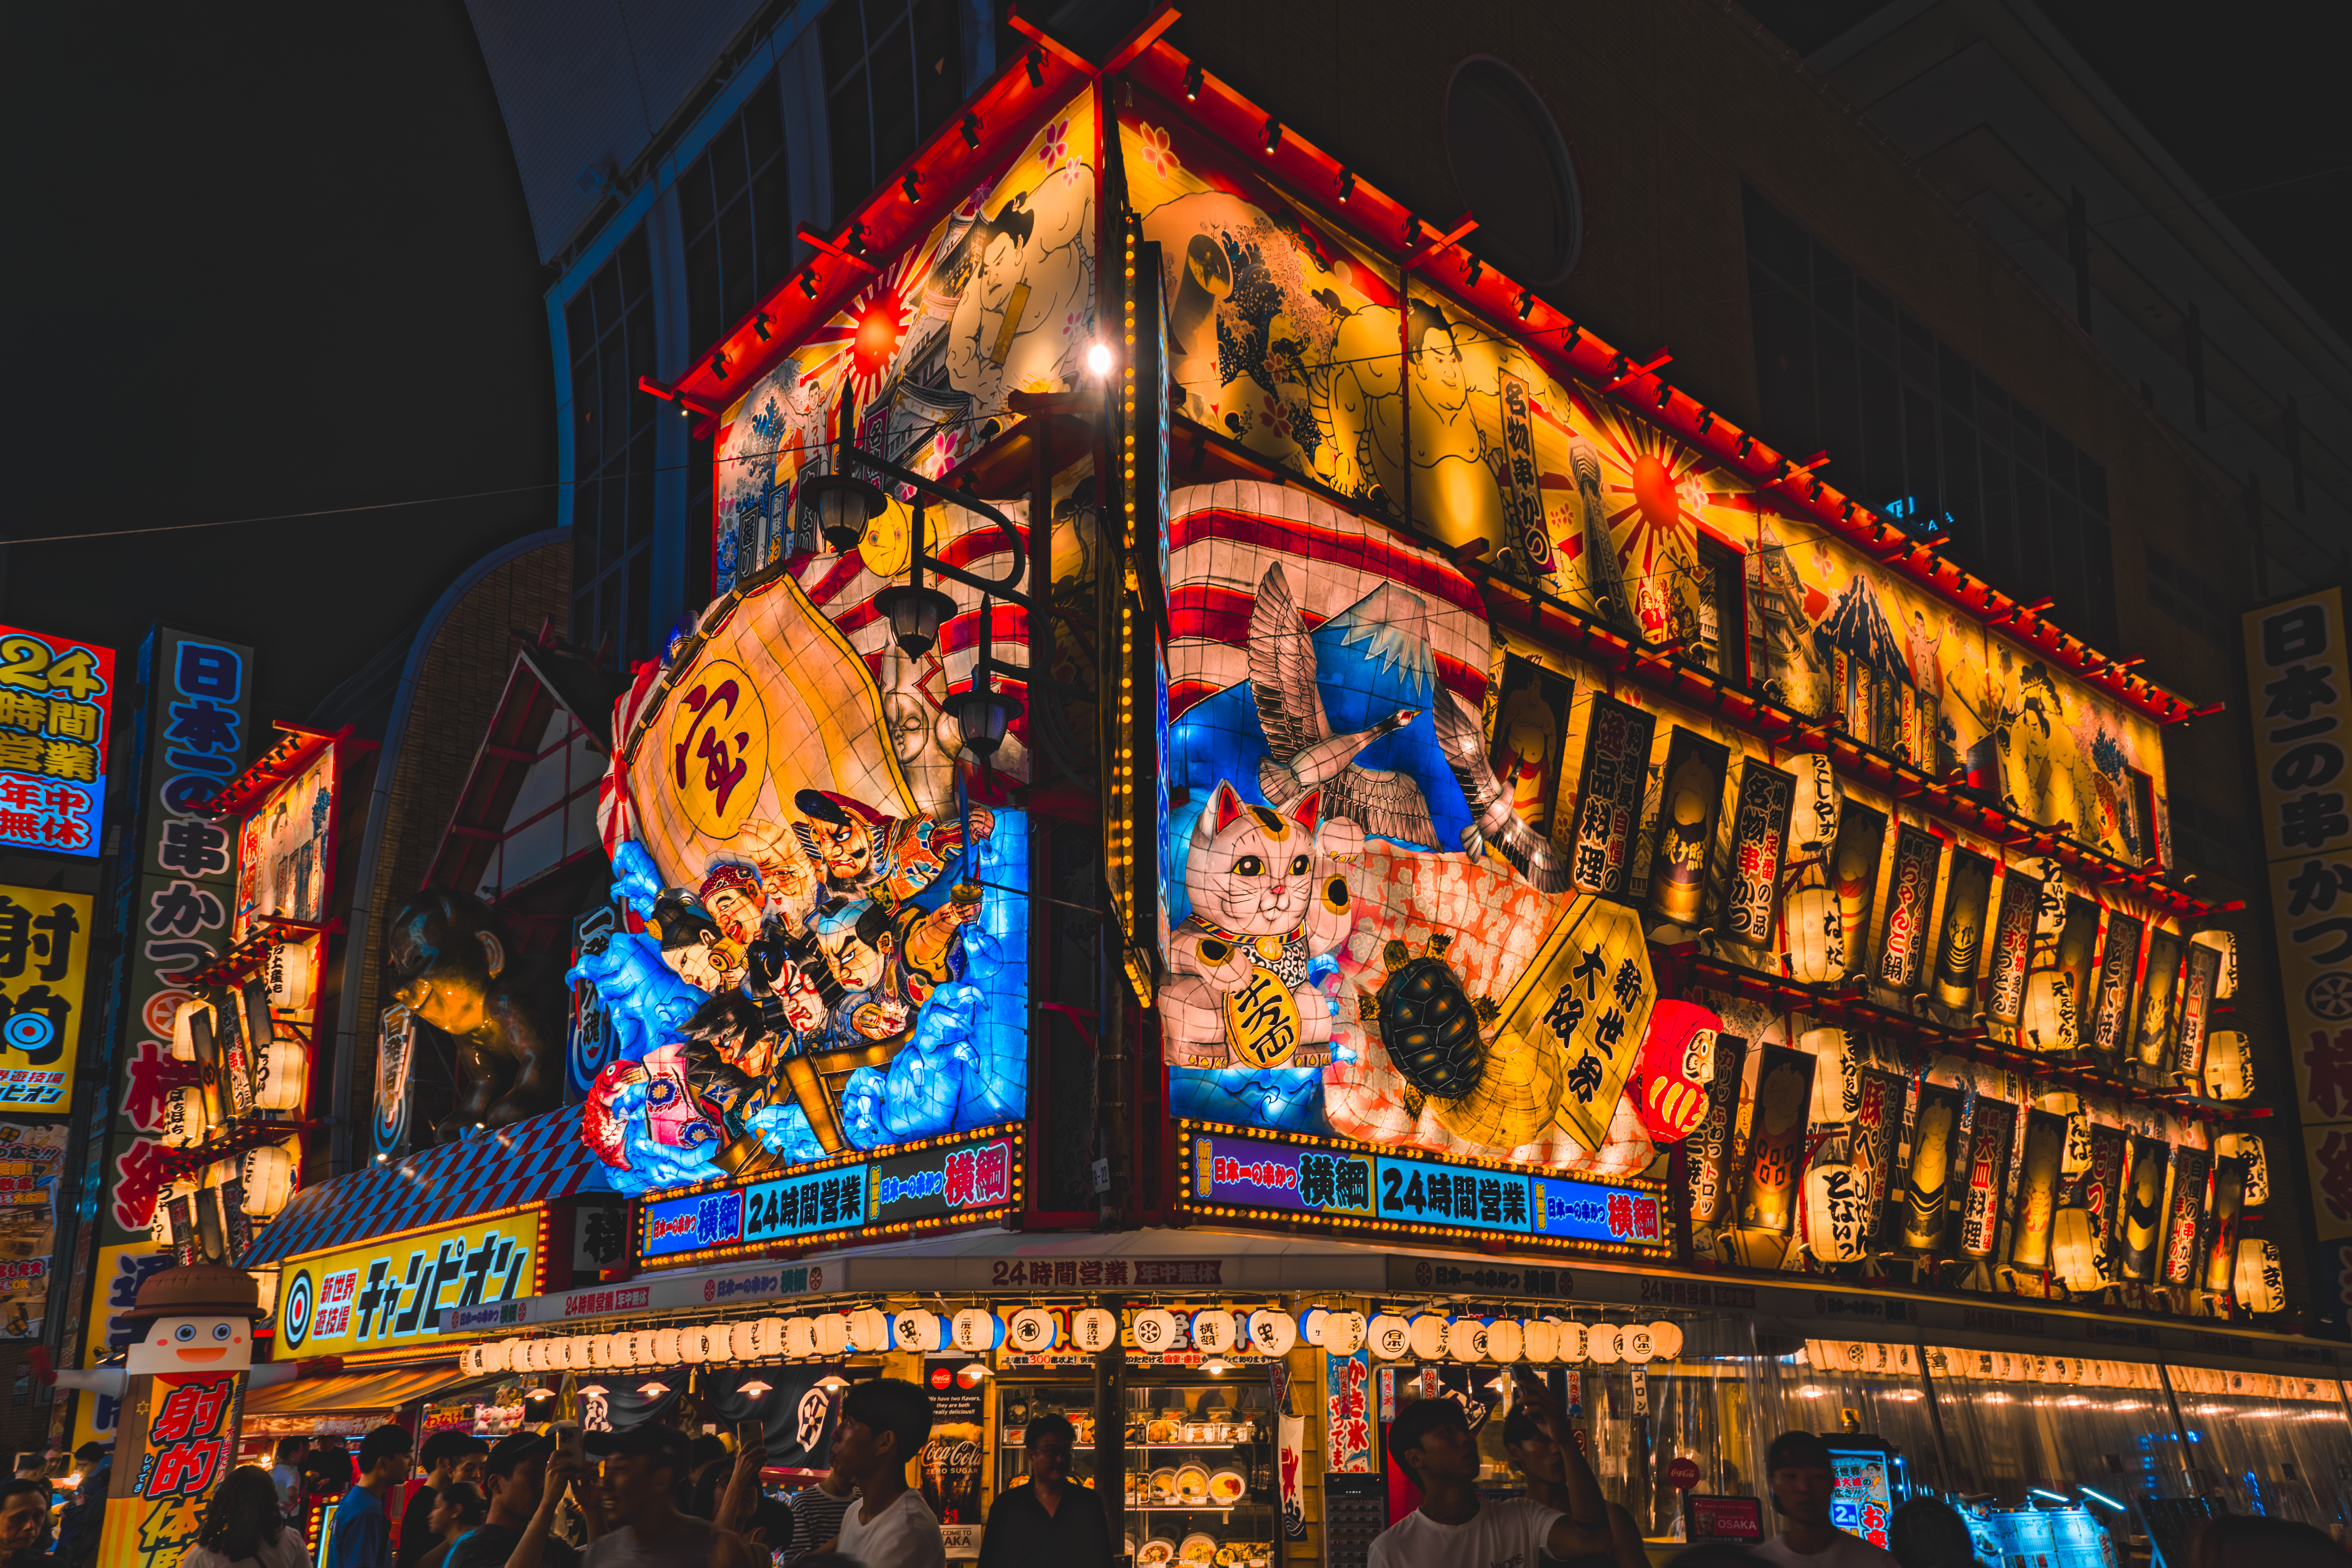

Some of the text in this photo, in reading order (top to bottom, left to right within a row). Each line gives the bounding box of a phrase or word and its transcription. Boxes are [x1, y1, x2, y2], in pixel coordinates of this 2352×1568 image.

[1504, 381, 1550, 564] 名物串かつ
[0, 637, 104, 700] 24
[0, 692, 100, 741] 時間
[0, 731, 94, 781] 営業
[0, 779, 87, 816] 年中
[1574, 708, 1626, 891] 逸品料理
[0, 812, 86, 845] 無休
[1729, 772, 1772, 933] 名物串かつ
[944, 1143, 1009, 1207] 横綱
[1196, 1139, 1212, 1196] 新世界
[1214, 1156, 1297, 1189] 日本一の串かつ
[1299, 1153, 1369, 1210] 横綱
[882, 1170, 943, 1204] 日本一の串かつ
[1383, 1168, 1526, 1224] 24時間営業
[1963, 1129, 1995, 1251] 大皿料理
[697, 1193, 742, 1243] 横綱
[748, 1175, 860, 1235] 24時間営業
[1548, 1197, 1606, 1223] 日本一の串かつ
[1607, 1193, 1659, 1241] 横綱
[653, 1214, 696, 1240] 日本一の串かつ
[321, 1272, 357, 1303] 新世界
[358, 1232, 527, 1341] チャンピオン
[717, 1275, 778, 1297] 日本一の串かつ
[780, 1268, 807, 1294] 横綱
[992, 1261, 1128, 1286] 24時間営業
[1140, 1263, 1216, 1283] 年中無休
[1436, 1266, 1519, 1289] 日本一の串かつ
[1524, 1270, 1556, 1295] 横綱
[565, 1291, 614, 1316] 24時間営業
[617, 1290, 647, 1307] 年中無休
[1641, 1278, 1711, 1306] 24時間営業
[314, 1304, 349, 1337] 遊技場
[1200, 1323, 1216, 1346] 横綱
[1271, 1366, 1287, 1400] かき氷
[1340, 1368, 1349, 1403] かき氷
[1384, 1371, 1392, 1406] かき氷
[1569, 1372, 1581, 1404] かき氷
[1634, 1373, 1646, 1411] メロン
[1348, 1359, 1367, 1451] かき氷
[147, 1382, 229, 1496] 射的
[134, 1454, 154, 1494] しゃてき
[1718, 1519, 1757, 1531] OSAKA
